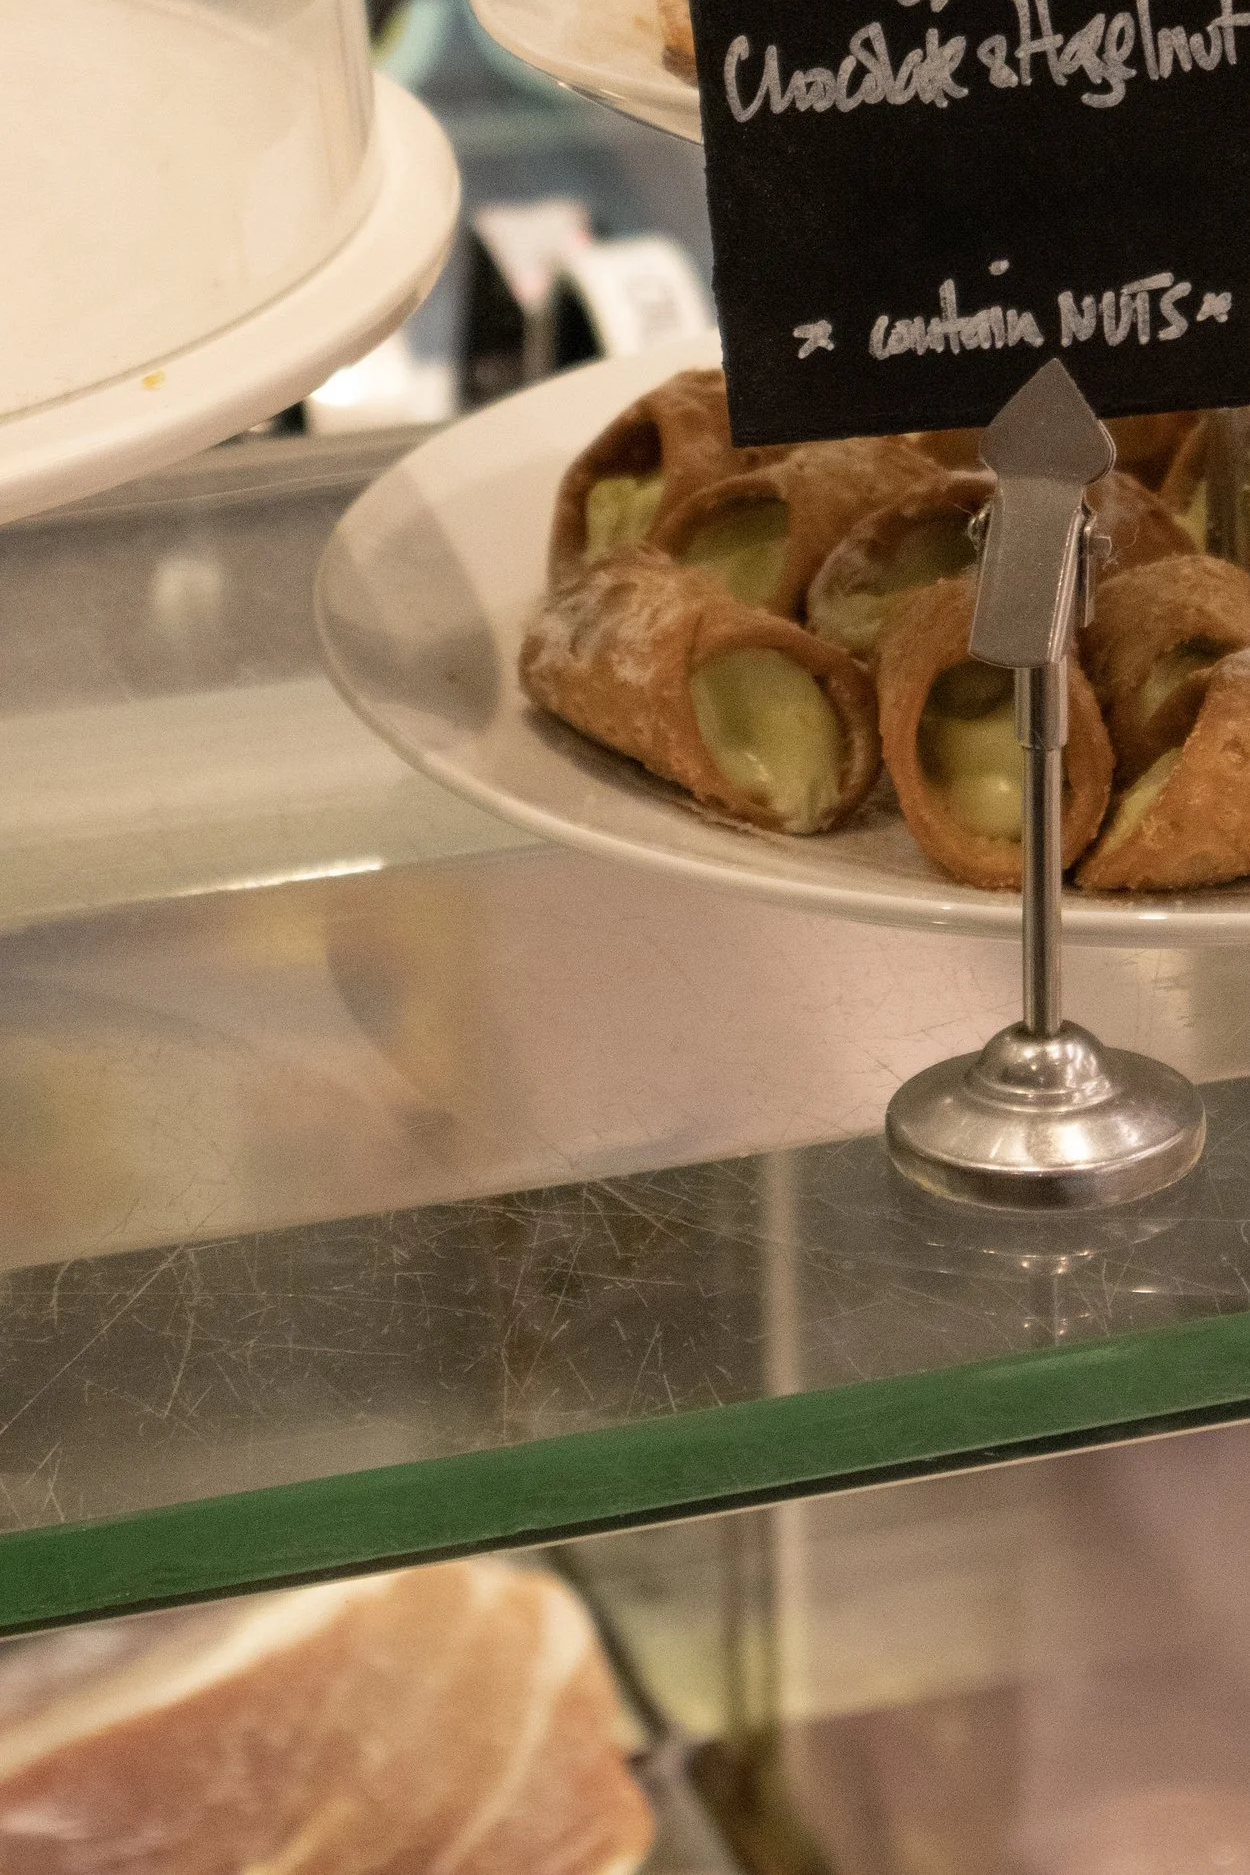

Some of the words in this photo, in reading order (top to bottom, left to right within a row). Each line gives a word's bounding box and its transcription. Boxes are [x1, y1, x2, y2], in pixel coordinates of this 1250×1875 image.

[723, 21, 970, 123] Chocolate
[976, 34, 1019, 89] &
[869, 258, 1045, 361] contain
[1058, 271, 1192, 347] NUTS
